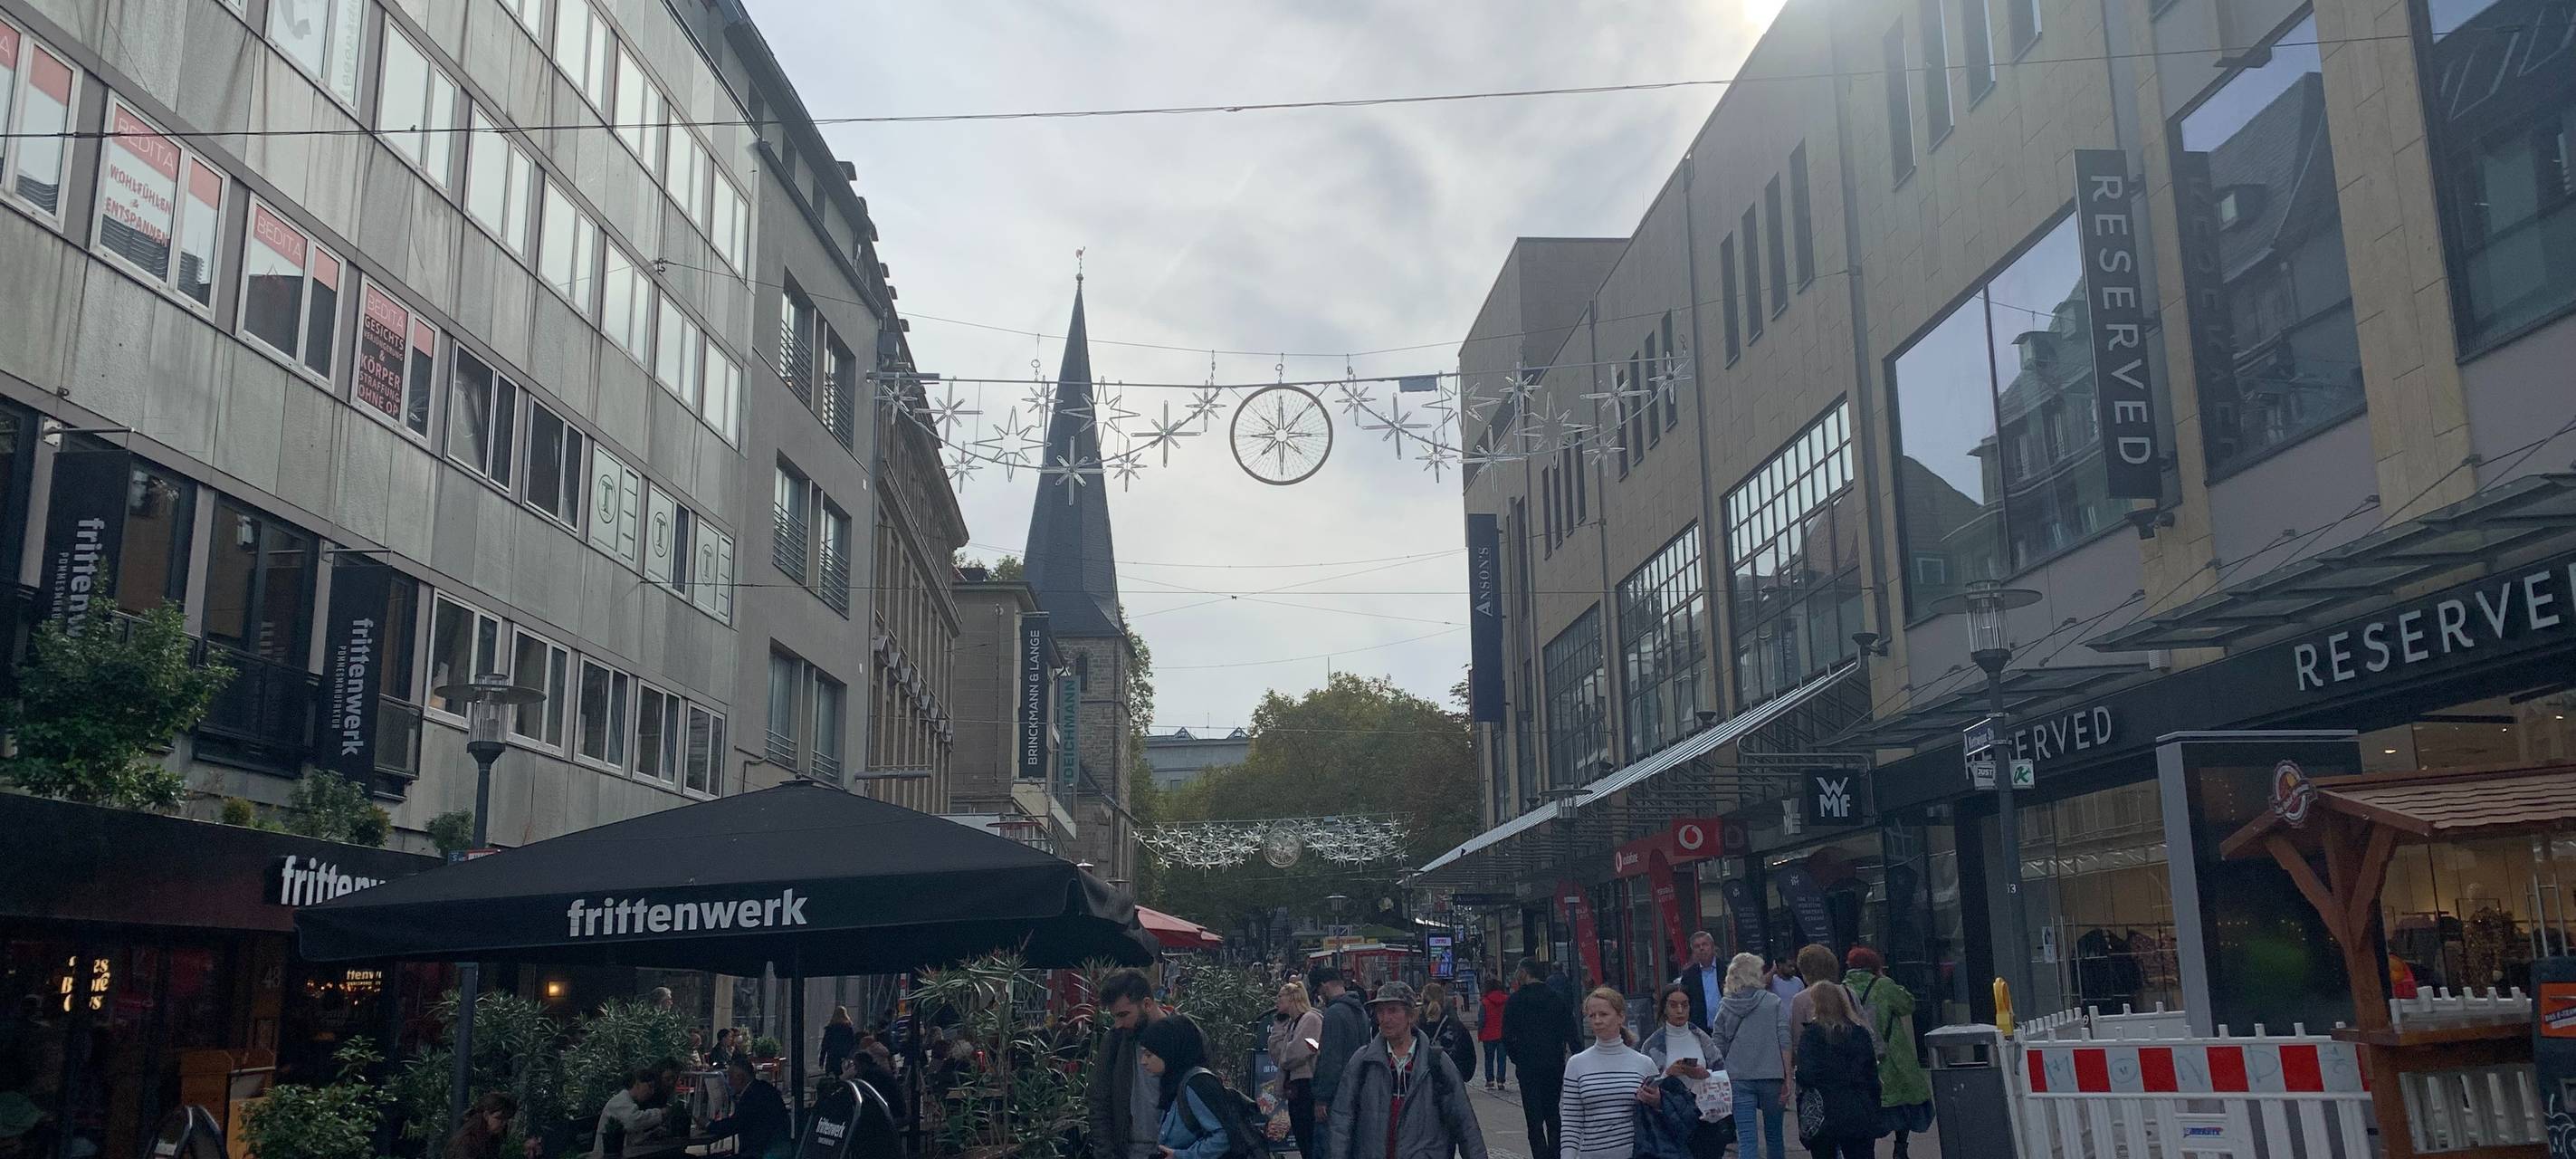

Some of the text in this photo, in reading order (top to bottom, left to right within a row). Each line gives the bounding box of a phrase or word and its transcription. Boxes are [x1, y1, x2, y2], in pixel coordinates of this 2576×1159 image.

[117, 117, 175, 174] BEDITA
[110, 163, 172, 216] WOHLFÜHLEN
[105, 196, 170, 247] ENTSPANNEN
[256, 215, 302, 261] BEDITA
[364, 315, 405, 350] GESICHTS
[367, 293, 405, 332] BEDITA
[2090, 175, 2152, 465] RESERVED
[361, 352, 400, 390] KÖRPER
[378, 350, 386, 362] &
[358, 384, 399, 417] OHNE OP
[359, 370, 401, 403] STRAFFUNG
[66, 518, 106, 638] frittenw
[1475, 546, 1493, 618] ANSON'S
[2295, 561, 2576, 691] RESERVE
[340, 618, 375, 756] frittenwerk
[1027, 629, 1041, 765] BRINCKMANN & LANGE
[1064, 680, 1075, 780] DEICHMANN
[1963, 706, 2112, 780] ERVED
[1816, 776, 1852, 818] WMF
[281, 855, 386, 906] fritten
[567, 888, 808, 936] frittenwerk
